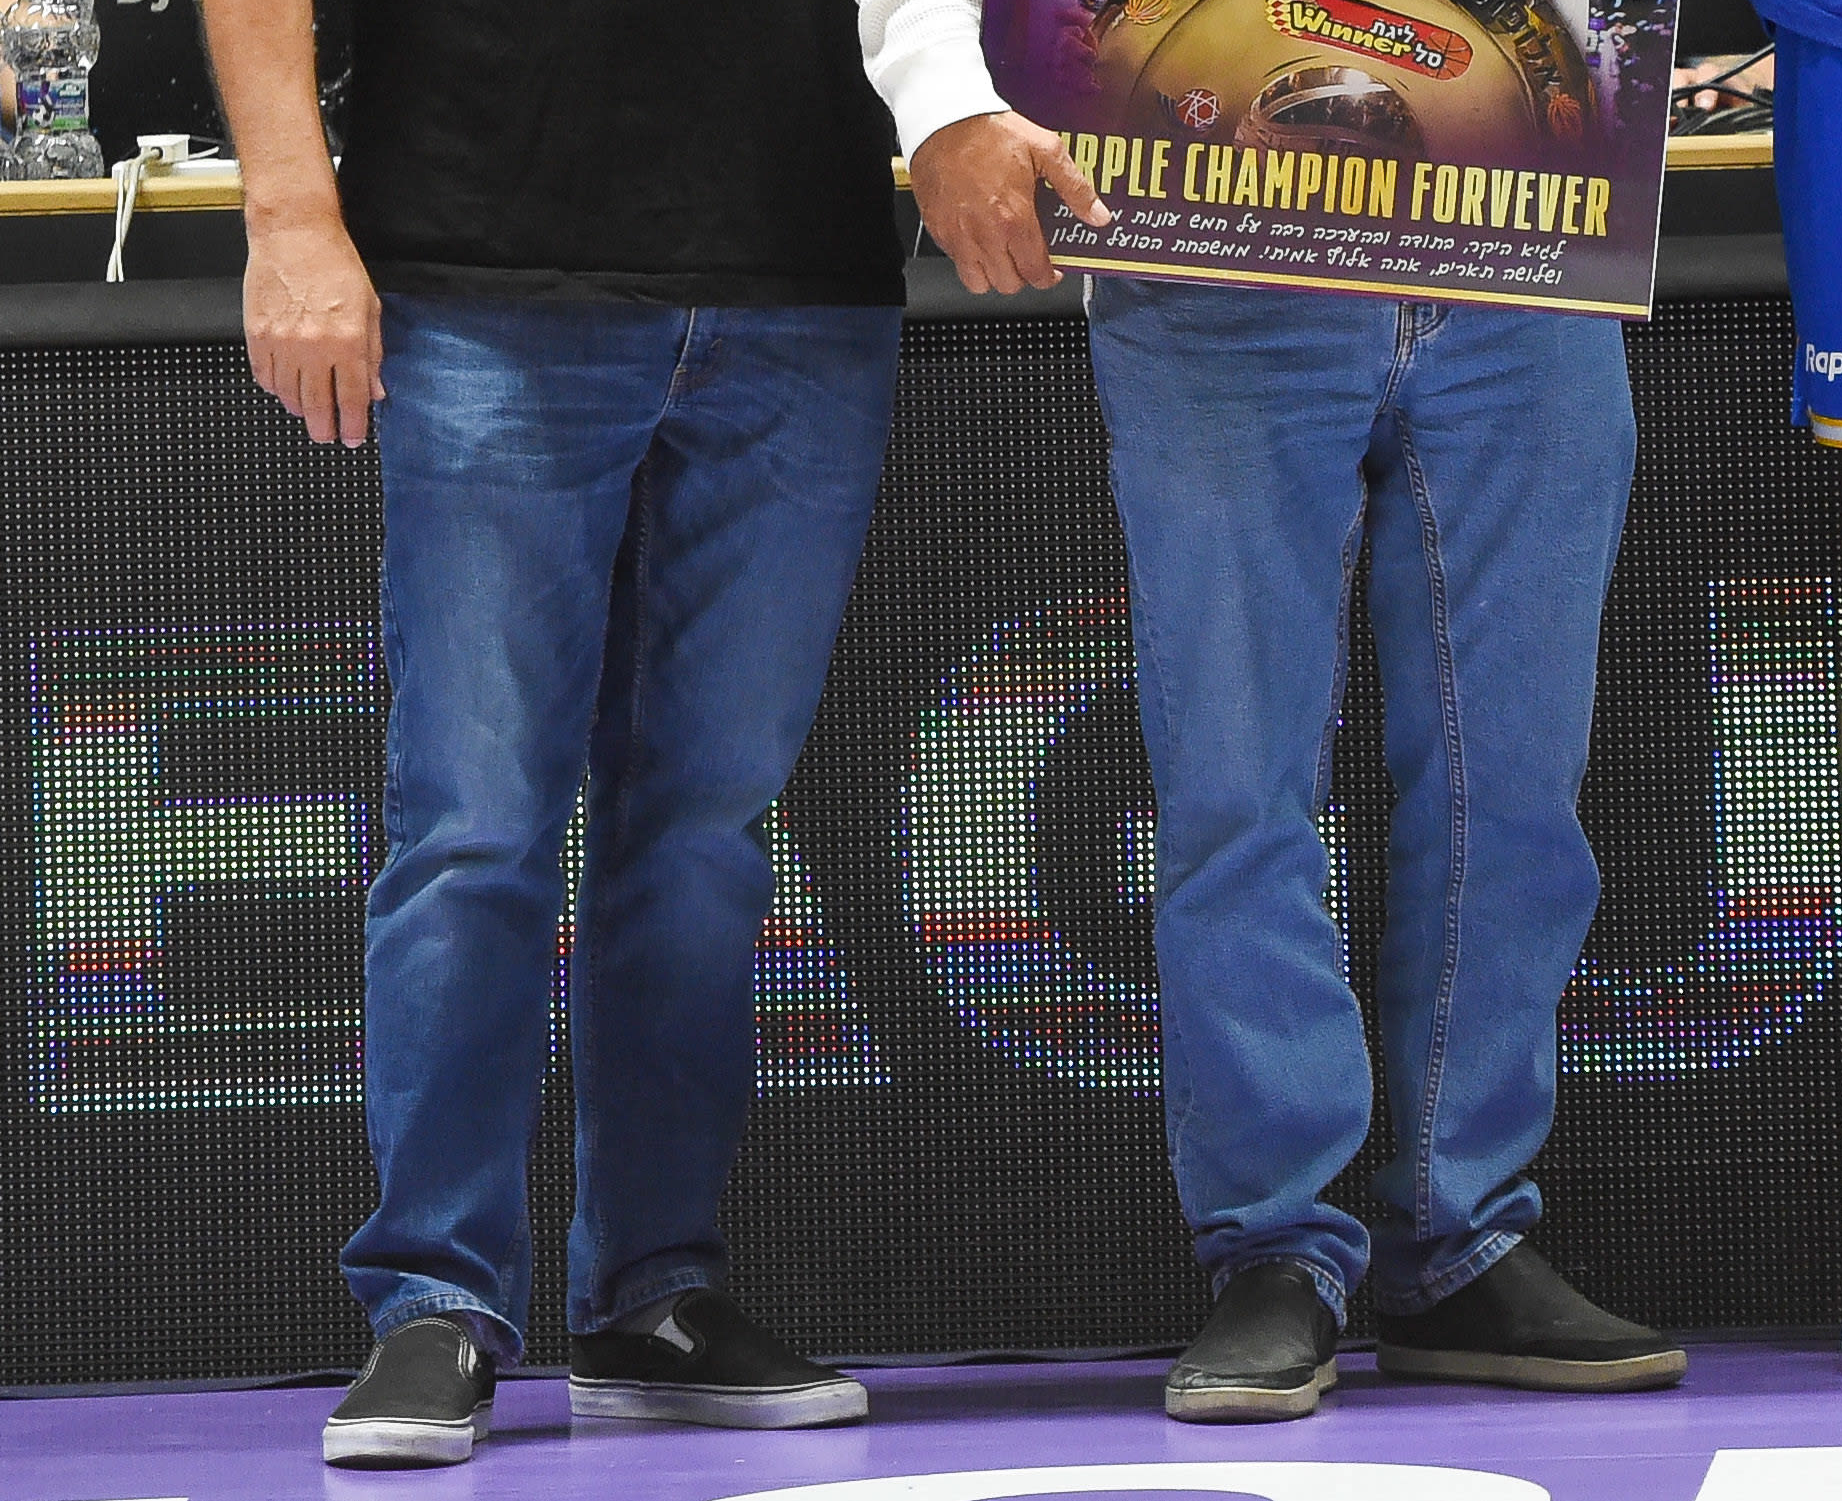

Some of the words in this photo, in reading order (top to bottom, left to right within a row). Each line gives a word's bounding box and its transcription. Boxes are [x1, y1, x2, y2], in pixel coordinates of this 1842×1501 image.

[1292, 2, 1412, 57] Winner
[1413, 42, 1443, 68] סל
[1370, 19, 1416, 43] ליגת
[1183, 142, 1398, 219] CHAMPION
[1410, 162, 1610, 237] FORVEVER
[1131, 209, 1181, 228] עונות
[1189, 212, 1228, 233] חמש
[1236, 213, 1261, 234] על
[1050, 226, 1098, 247] חולון
[1107, 226, 1163, 250] הפועל
[1269, 223, 1305, 239] רבה
[1312, 225, 1391, 246] ובהערכה
[1399, 232, 1456, 251] בתודה
[1171, 240, 1251, 259] ממשפחת
[1327, 247, 1372, 269] אלוף
[1520, 240, 1567, 261] לגיא
[1380, 257, 1421, 274] אתה
[1502, 263, 1563, 285] ושלושה
